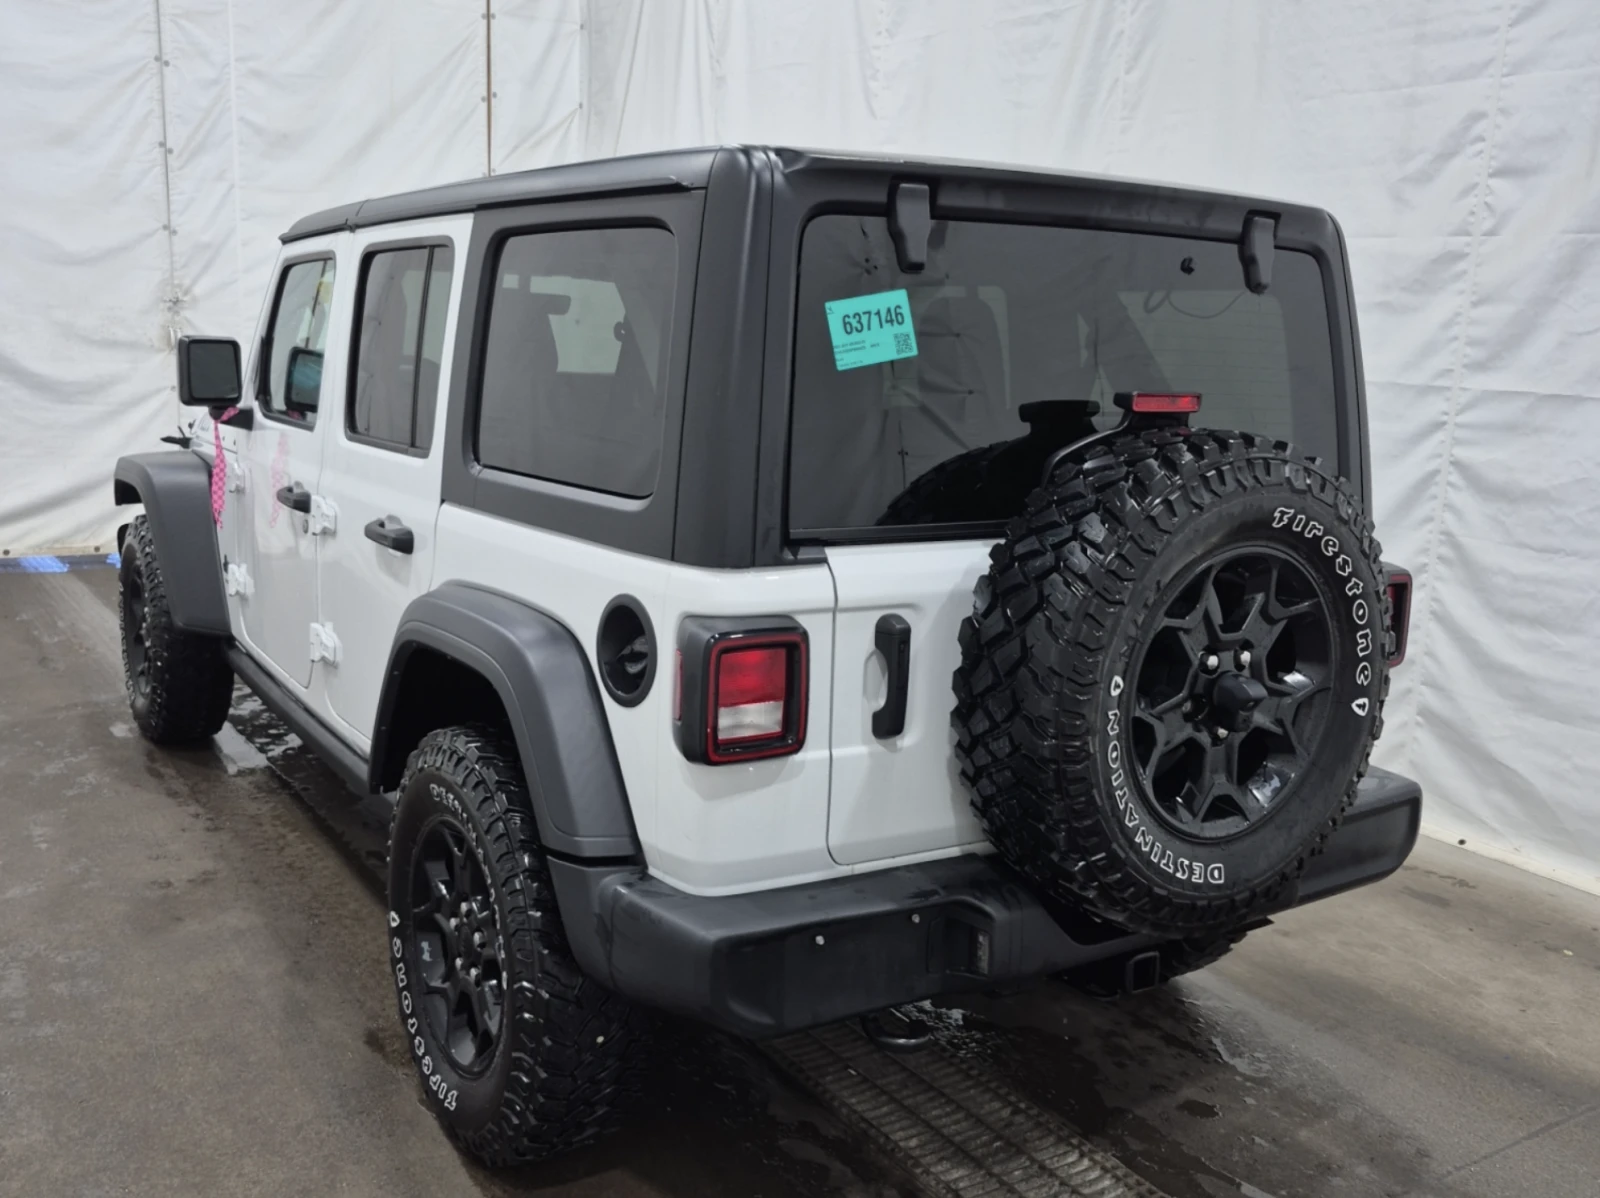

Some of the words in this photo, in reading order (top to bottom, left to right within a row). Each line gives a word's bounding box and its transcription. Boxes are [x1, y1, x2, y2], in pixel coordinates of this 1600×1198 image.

[842, 304, 905, 335] 637146
[1272, 507, 1372, 686] Firestone
[1107, 709, 1224, 884] DESTINATION
[393, 936, 457, 1111] Firestone
